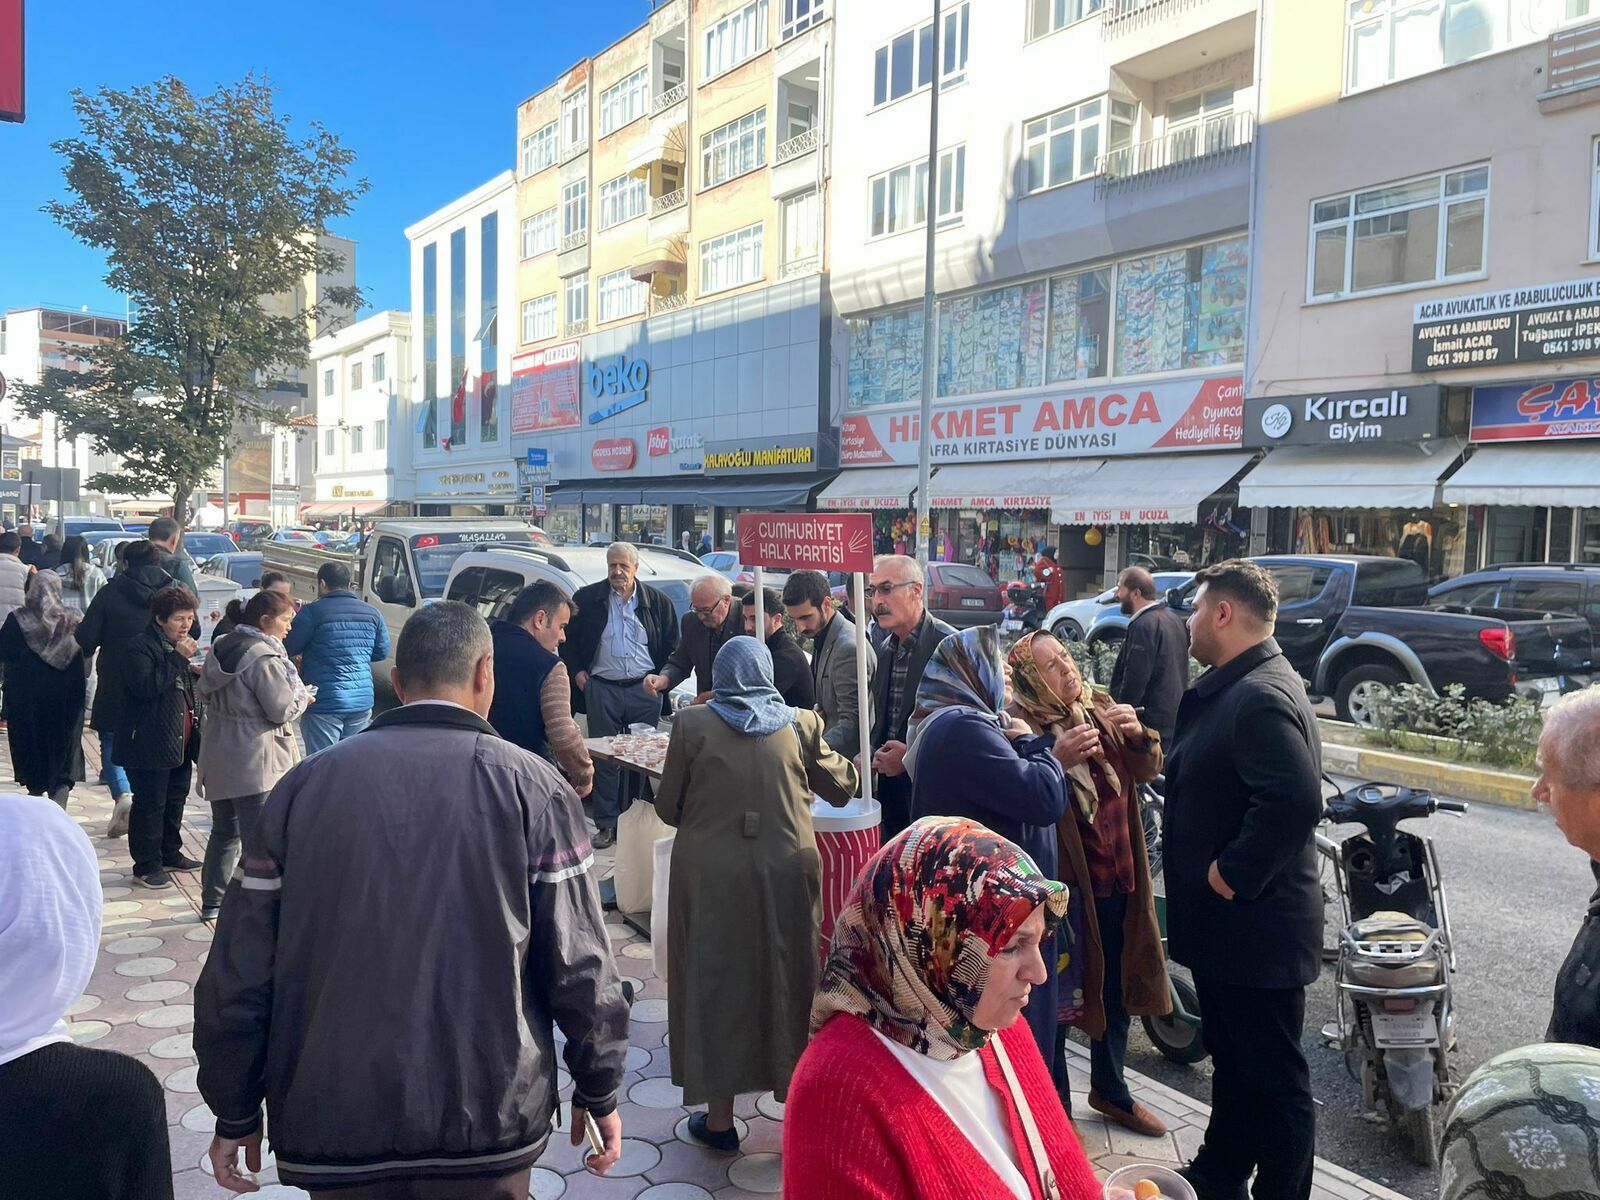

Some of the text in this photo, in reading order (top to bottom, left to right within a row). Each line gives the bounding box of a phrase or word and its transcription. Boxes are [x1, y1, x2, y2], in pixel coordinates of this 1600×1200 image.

[1420, 304, 1443, 319] ACAR
[1445, 296, 1496, 315] AVUKATLIK
[1499, 293, 1511, 308] VE
[1514, 282, 1593, 306] ARABULUCULUK
[1527, 309, 1564, 326] AVUKAT
[1419, 324, 1451, 340] AVUKAT
[1459, 317, 1511, 335] ARABULUCU
[1522, 326, 1573, 343] Tuğbanur
[1464, 334, 1492, 349] ACAR
[1543, 341, 1569, 355] 0541
[1571, 338, 1591, 352] 398
[1427, 353, 1450, 367] 0541
[1452, 351, 1470, 364] 398
[588, 355, 649, 398] beko
[1032, 391, 1162, 432] AMCA
[1304, 390, 1408, 422] Kırcalı
[1517, 380, 1600, 423] ÇA
[1045, 432, 1117, 450] DÜNYASI
[1329, 421, 1382, 443] Giyim
[704, 448, 752, 468] KALAYOĞLU
[970, 497, 995, 506] AMCA
[1075, 511, 1085, 521] EN
[1120, 511, 1131, 520] EN
[1139, 510, 1169, 521] UCUZA
[758, 519, 843, 541] CUMHURİYET
[760, 541, 844, 564] HALK PARTİSİ
